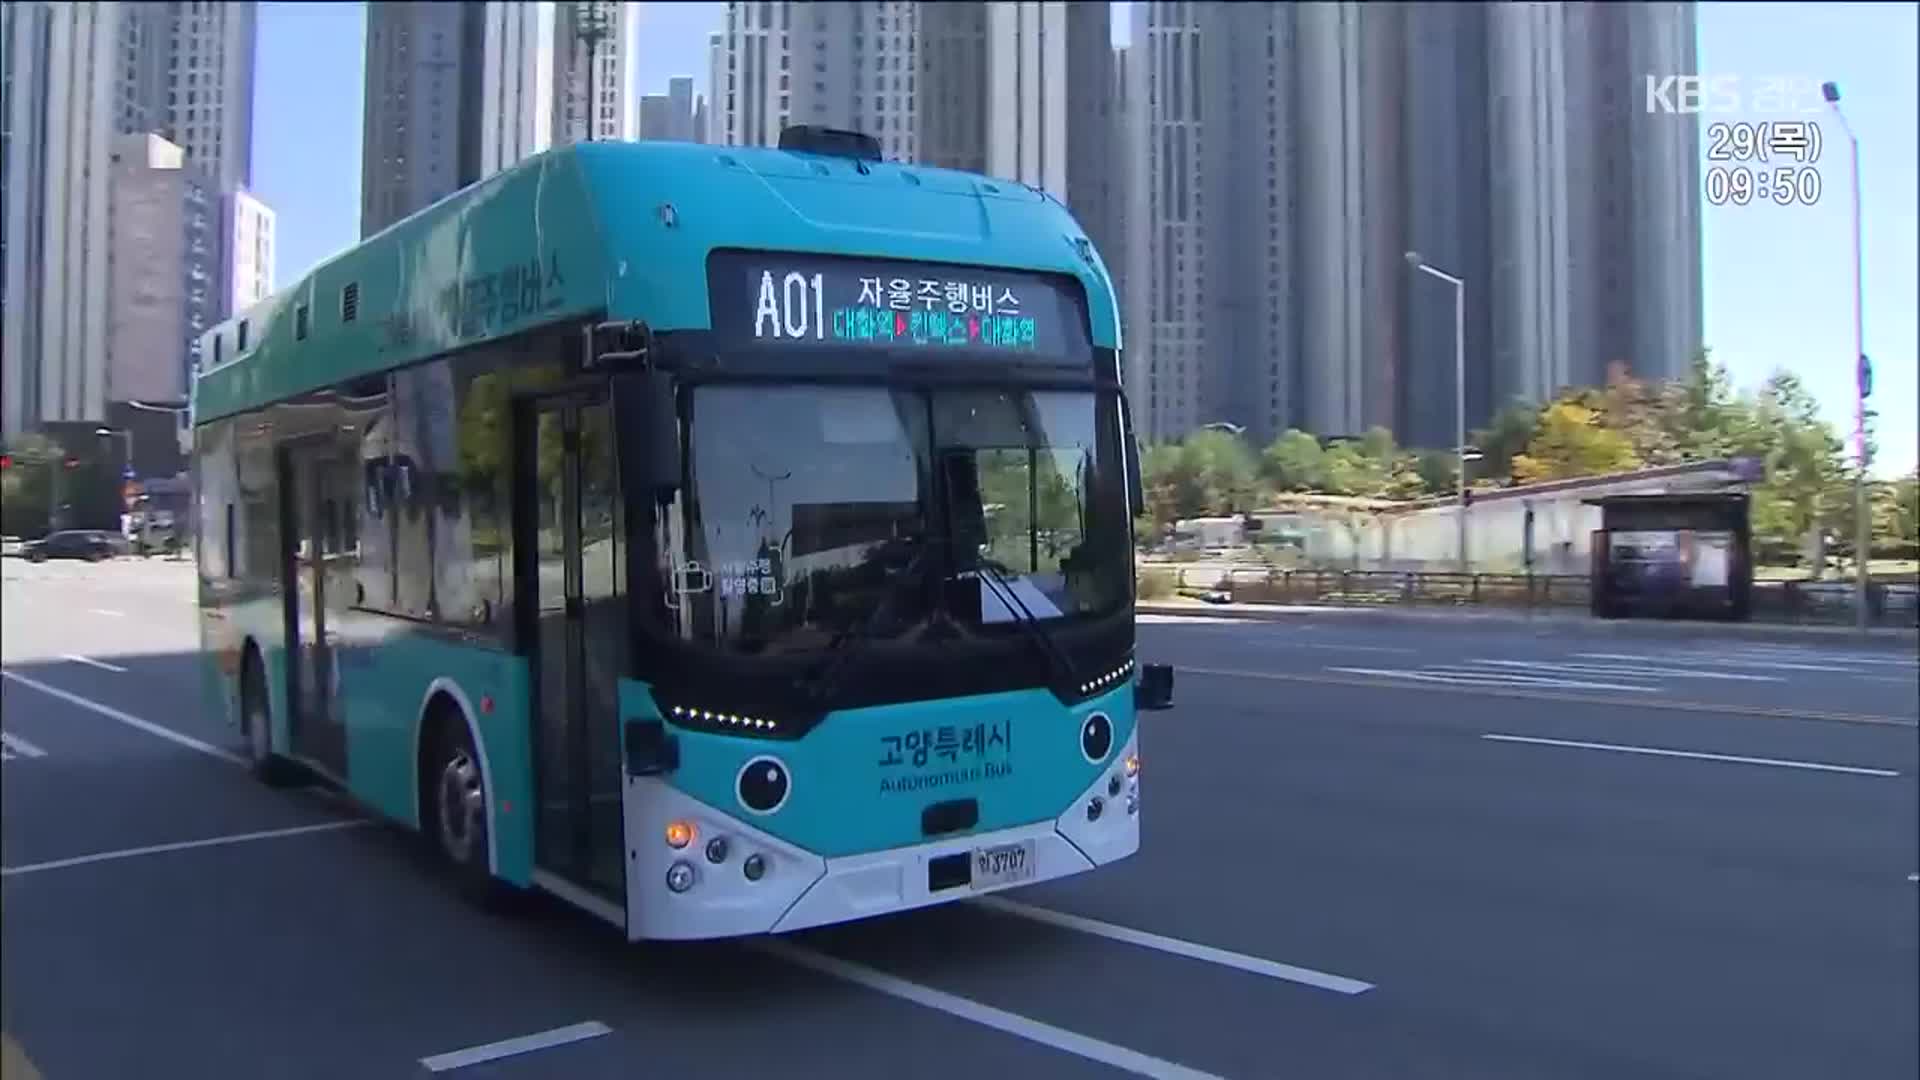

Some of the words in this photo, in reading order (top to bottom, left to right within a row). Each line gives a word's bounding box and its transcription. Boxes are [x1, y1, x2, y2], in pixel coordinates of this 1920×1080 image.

[755, 269, 824, 339] A01
[857, 275, 1020, 316] 자율주행버스
[832, 307, 894, 342] 대화역
[982, 315, 1035, 347] 대화역
[878, 719, 1011, 767] 고양특례시
